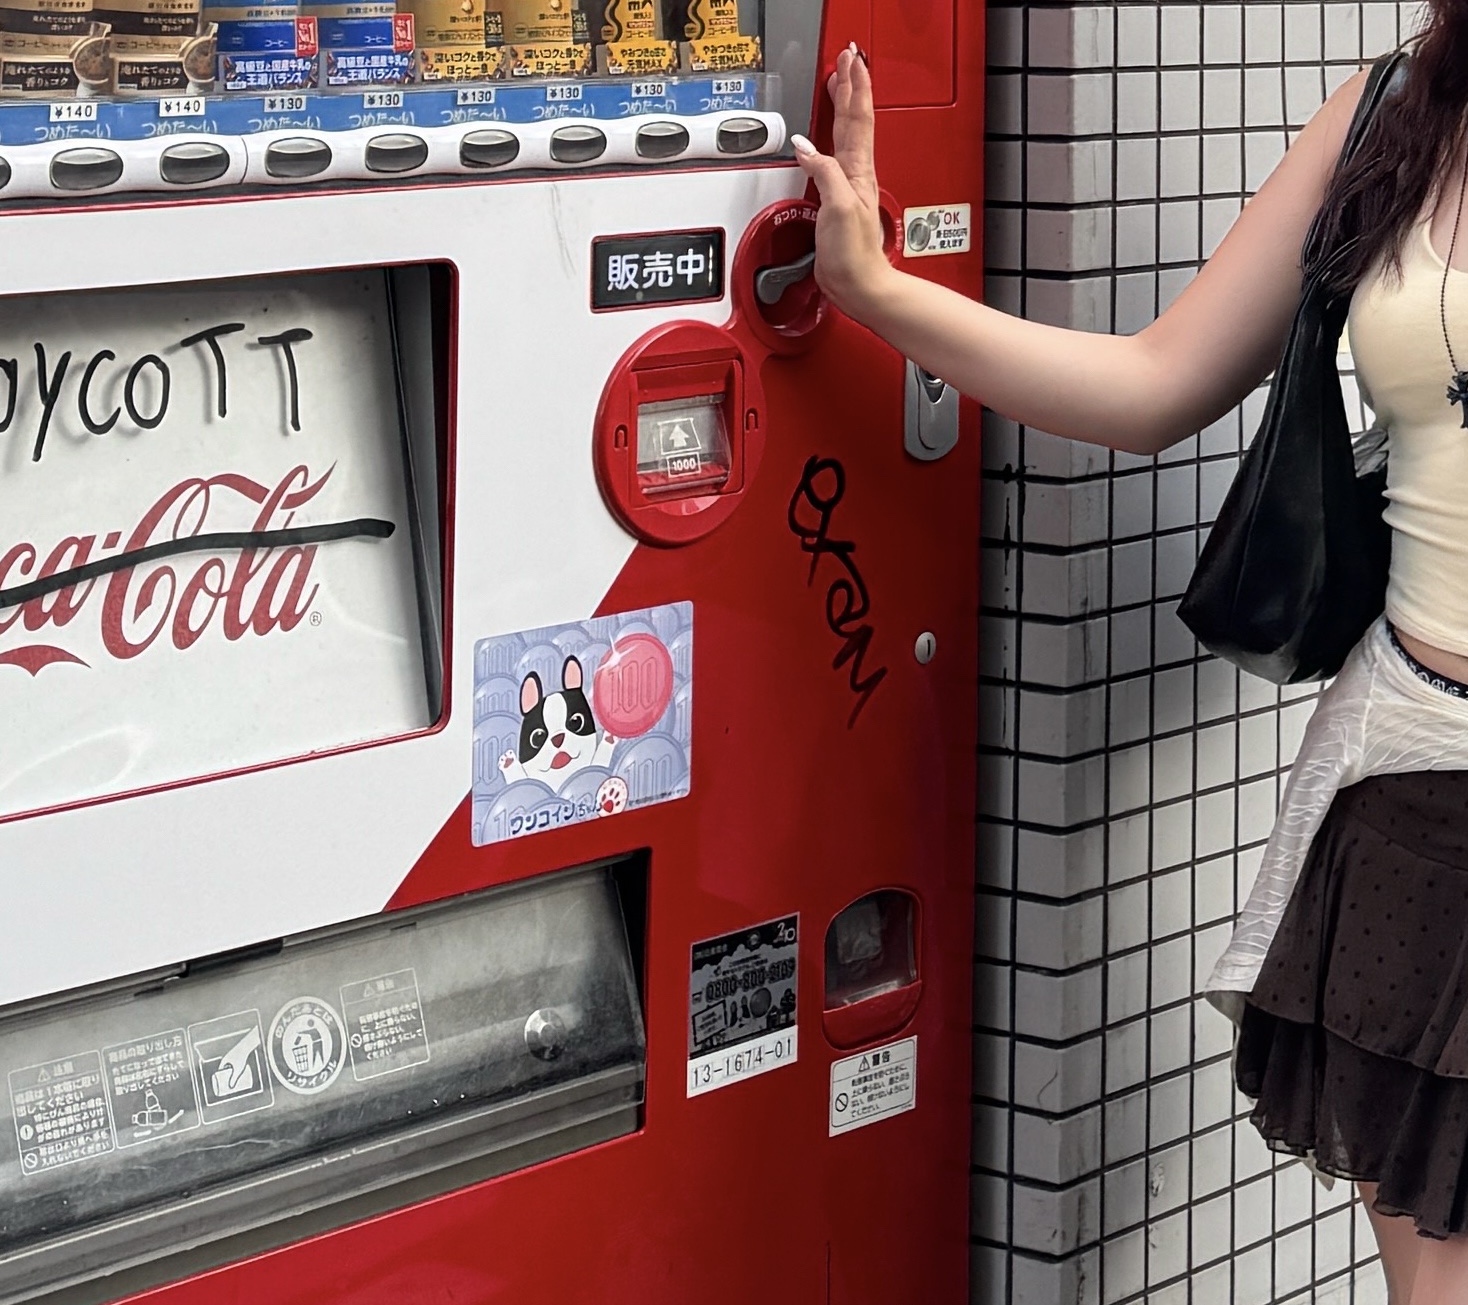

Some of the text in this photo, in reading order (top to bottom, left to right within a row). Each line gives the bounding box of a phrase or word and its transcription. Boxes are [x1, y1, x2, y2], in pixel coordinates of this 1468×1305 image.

[944, 211, 960, 225] OK
[607, 248, 704, 291] 販売中
[0, 322, 313, 463] OYCOTT
[672, 457, 696, 472] 1000
[608, 656, 658, 715] 100
[275, 1003, 335, 1039] のんだあとは
[287, 1059, 338, 1087] リサイクル
[692, 1037, 793, 1084] 13-1674-01
